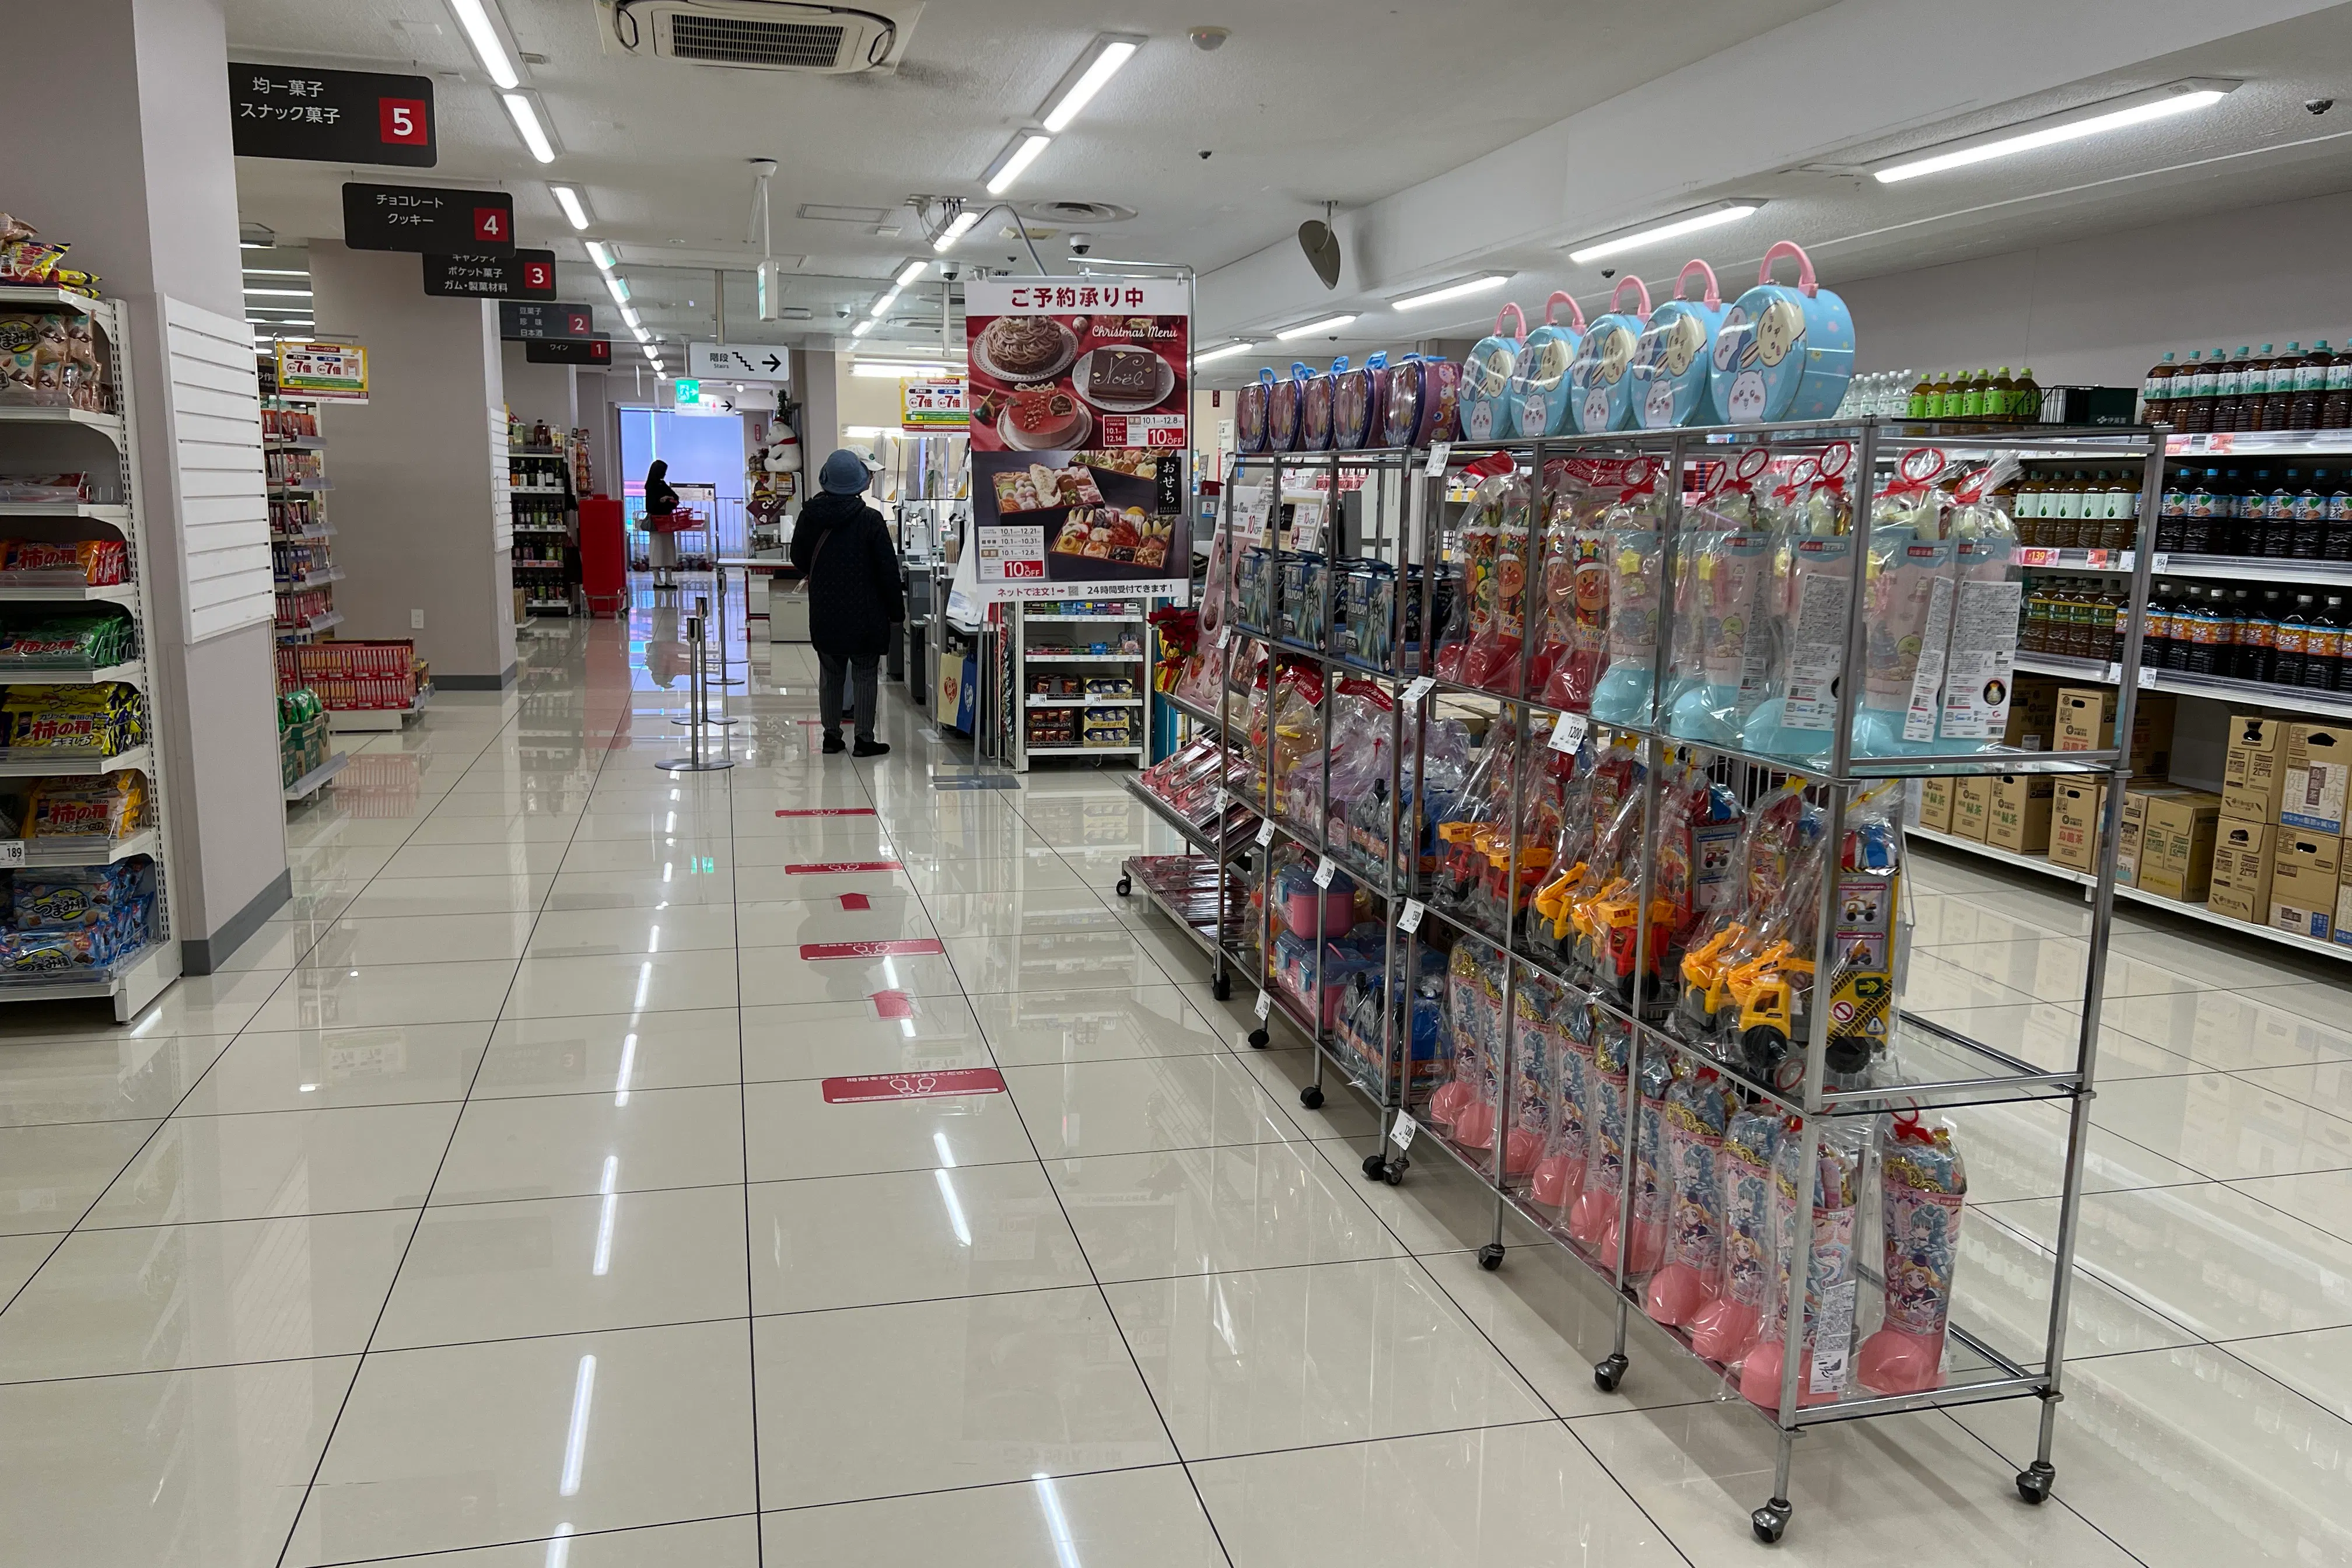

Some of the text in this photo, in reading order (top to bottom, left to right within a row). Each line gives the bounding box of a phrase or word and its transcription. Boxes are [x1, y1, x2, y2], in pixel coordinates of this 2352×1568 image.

[253, 77, 324, 97] 均一菓子
[240, 103, 341, 124] スナック菓子
[393, 107, 414, 136] 5
[376, 194, 444, 208] チョコレート
[387, 213, 434, 226] クッキー
[483, 215, 499, 235] 4
[448, 266, 503, 278] ポケット菓子
[531, 267, 545, 285] 3
[1011, 286, 1144, 309] ご予約承り中
[574, 317, 584, 331] 2
[1092, 325, 1178, 338] Christmas Menu
[596, 344, 601, 355] 1
[709, 352, 729, 363] 階段
[1163, 416, 1178, 425] 12.8
[1163, 461, 1175, 503] おせち
[1087, 584, 1173, 595] 24時間受付できます！
[32, 720, 92, 741] 柿の種
[1567, 726, 1583, 740] 1200
[50, 802, 108, 824] 柿の種
[6, 847, 22, 858] 189
